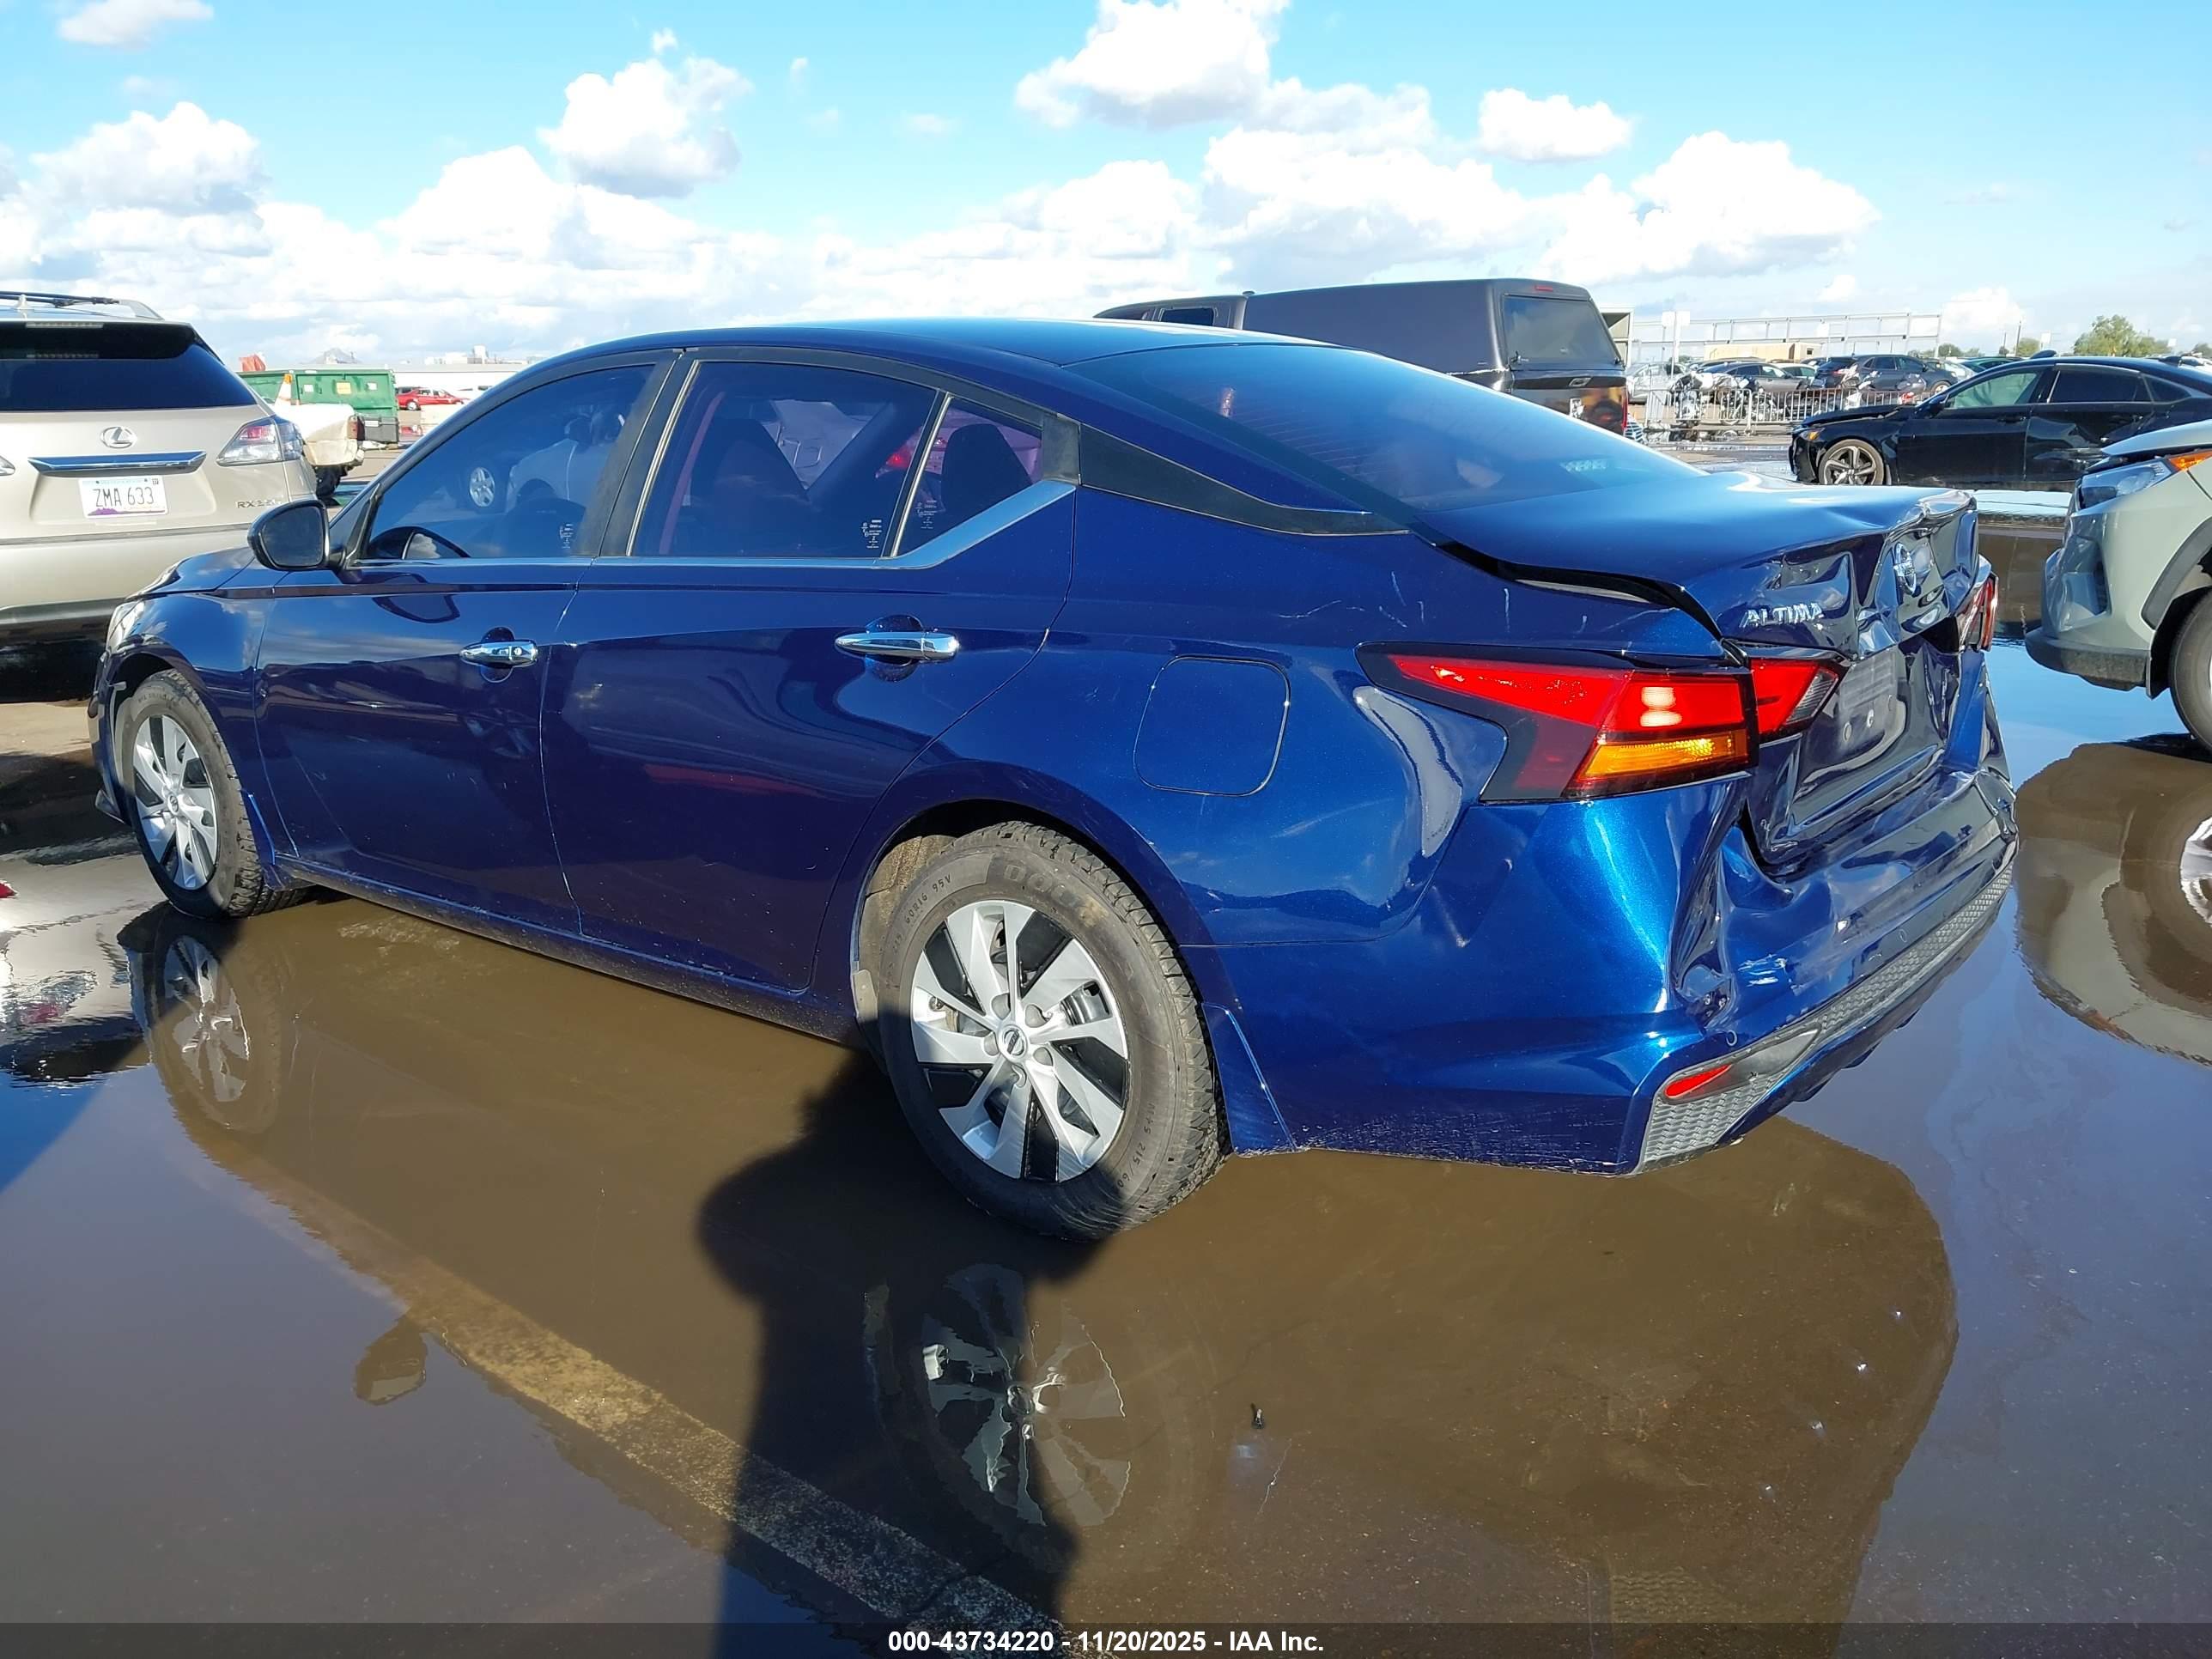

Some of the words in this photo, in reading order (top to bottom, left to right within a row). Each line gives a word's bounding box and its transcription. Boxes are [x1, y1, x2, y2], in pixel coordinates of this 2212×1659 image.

[93, 488, 122, 507] ZMA
[128, 487, 154, 505] 633
[1739, 603, 1824, 628] ALTIMA
